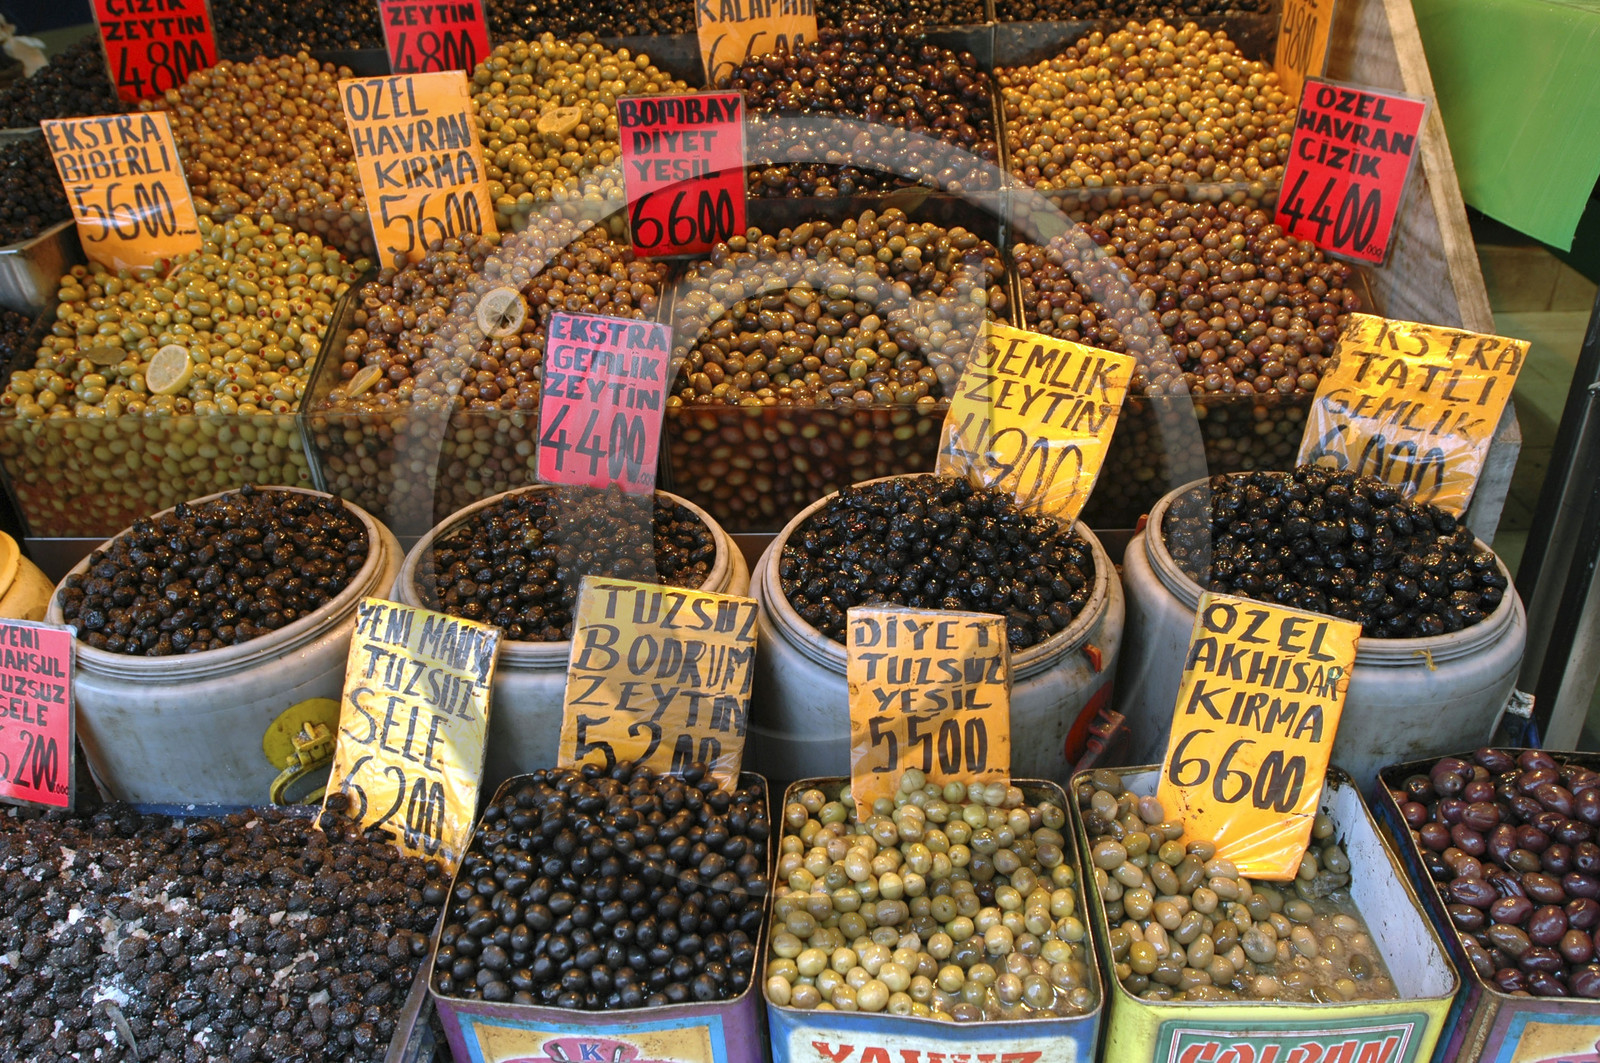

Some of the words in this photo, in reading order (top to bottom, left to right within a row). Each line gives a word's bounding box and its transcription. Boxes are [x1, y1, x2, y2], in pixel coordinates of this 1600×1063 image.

[393, 28, 476, 78] 4800
[45, 112, 163, 154] EKSTRA
[353, 111, 472, 158] HAVRAN
[619, 96, 742, 128] BOMBAY
[1296, 108, 1415, 157] HAVRAN
[57, 141, 172, 183] BİBERLİ
[373, 150, 480, 190] KIRMA
[378, 190, 483, 254] 5600
[552, 315, 668, 353] EKSTRA
[553, 344, 660, 383] GEMLİK
[1350, 349, 1498, 407] TATLI
[593, 584, 760, 642] TUZSUZ
[0, 647, 66, 679] AHSUL
[363, 643, 476, 722] TUZSUZ
[571, 623, 757, 696] BODRUM
[339, 686, 449, 774] SELE
[1185, 679, 1325, 744] KIRMA
[574, 713, 723, 777] 5200
[1168, 728, 1307, 814] 6600
